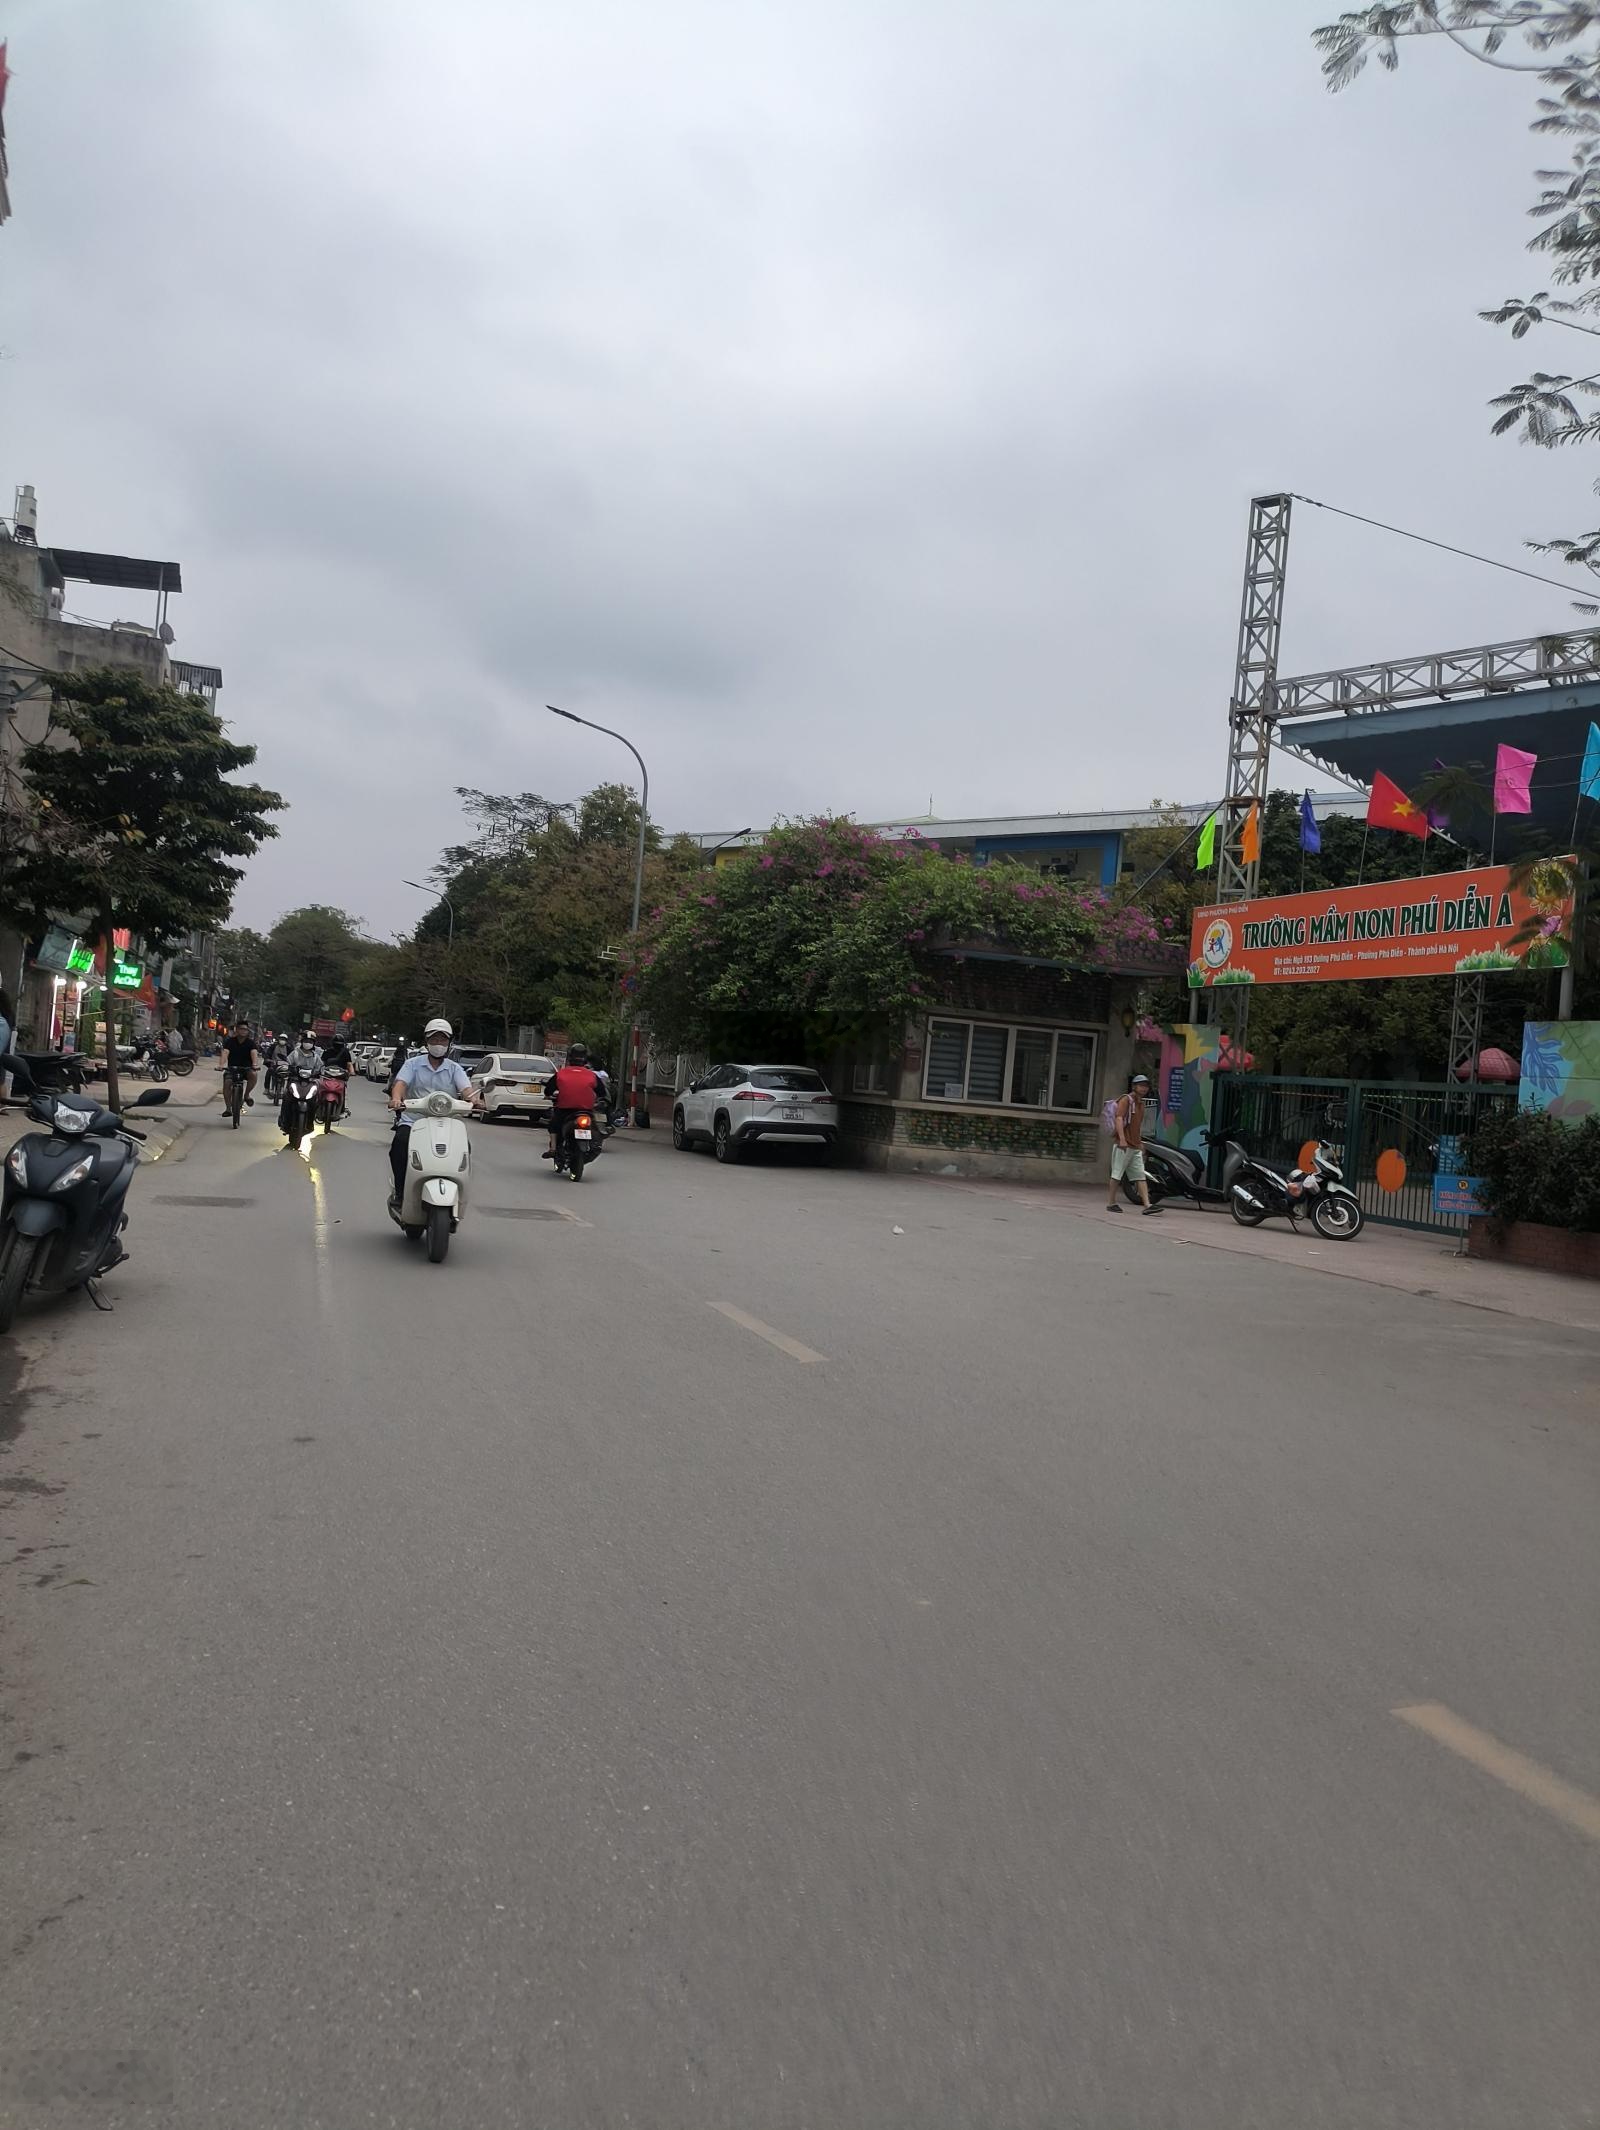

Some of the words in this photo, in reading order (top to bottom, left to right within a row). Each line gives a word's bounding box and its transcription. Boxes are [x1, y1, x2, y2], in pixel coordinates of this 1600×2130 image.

[1242, 914, 1306, 950] TRƯỜNG
[1308, 904, 1350, 945] MẦM
[1352, 907, 1396, 941] NON
[1399, 895, 1440, 936] PHÚ
[1442, 884, 1492, 932] DIỄN
[1495, 893, 1514, 927] A
